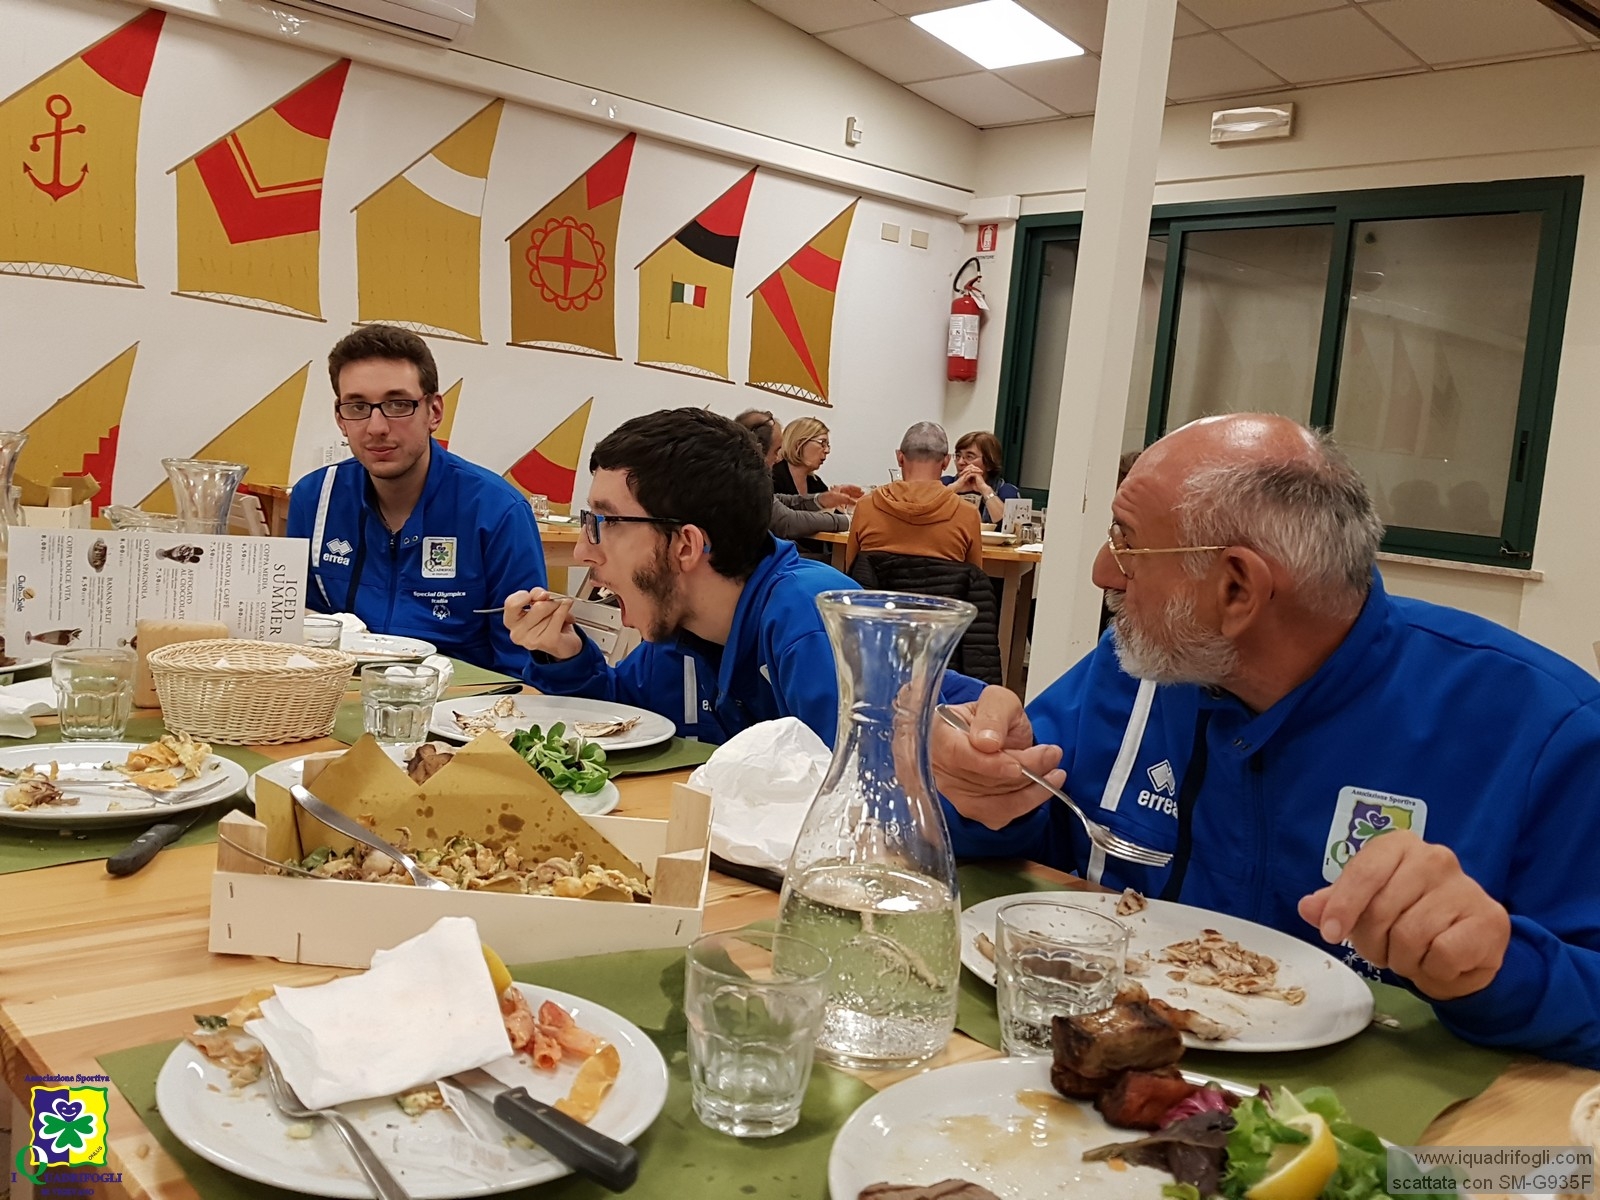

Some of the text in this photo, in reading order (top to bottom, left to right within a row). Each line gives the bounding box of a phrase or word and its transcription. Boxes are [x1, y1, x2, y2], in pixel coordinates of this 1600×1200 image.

[323, 553, 350, 566] errea
[180, 568, 186, 577] AL
[18, 575, 26, 591] Club
[141, 563, 149, 600] SPAGNOLA
[224, 579, 230, 588] AL
[64, 585, 72, 601] VITA
[269, 563, 286, 637] SUMMER
[284, 580, 298, 620] ICED
[17, 597, 25, 612] Sole
[1351, 789, 1416, 807] Associazione Sportiva
